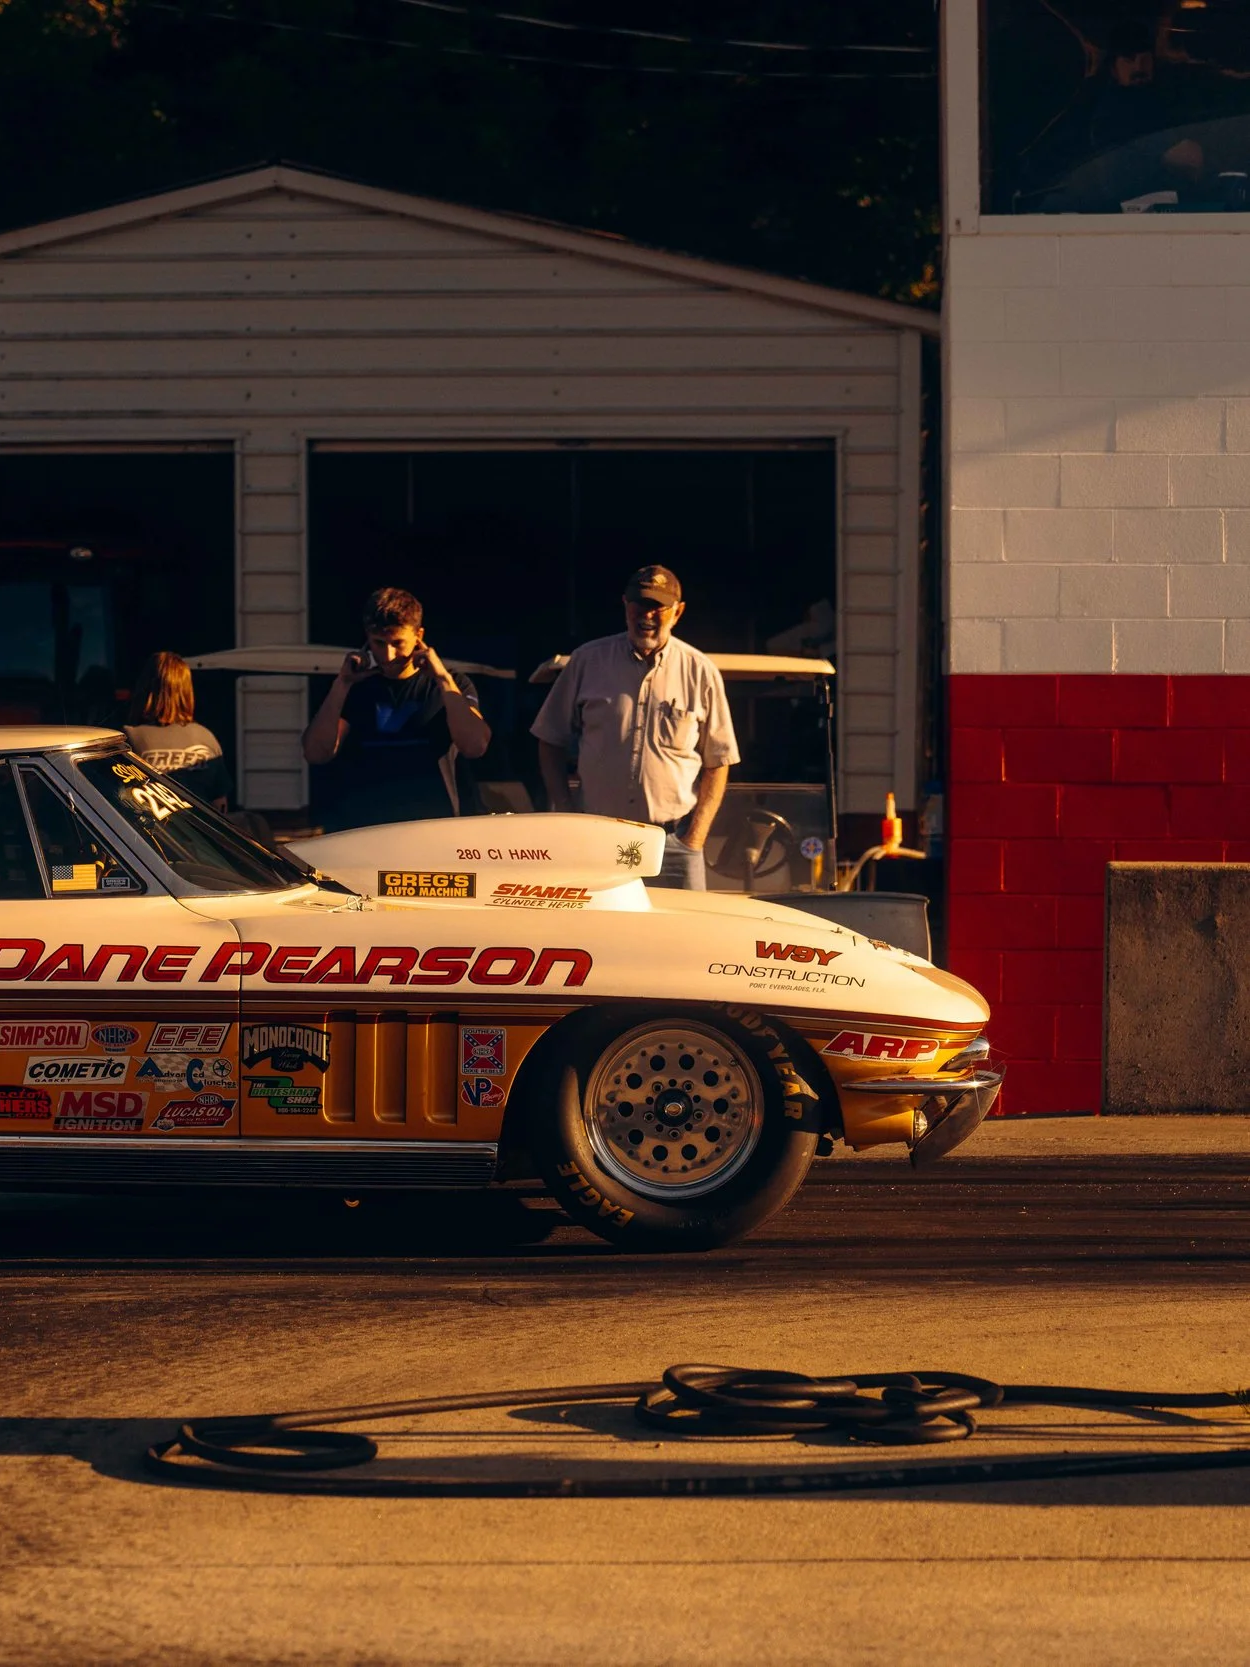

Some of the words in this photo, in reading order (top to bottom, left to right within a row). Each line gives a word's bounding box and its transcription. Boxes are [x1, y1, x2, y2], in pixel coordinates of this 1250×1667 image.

[132, 782, 193, 820] 2142
[456, 849, 481, 860] 280
[487, 849, 503, 860] CI
[508, 849, 552, 861] HAWK
[384, 873, 470, 888] GREG'S
[386, 886, 416, 896] AUTO
[418, 887, 468, 897] MACHINE
[492, 882, 593, 901] SHAMEL
[492, 897, 545, 908] CYLINDER
[547, 901, 585, 909] HEADS
[198, 942, 594, 987] PEARSON
[707, 963, 866, 988] CONSTRUCTION
[98, 1026, 133, 1043] NHRA
[152, 1025, 226, 1046] CFE
[243, 1026, 330, 1062] MONOCOQUE
[825, 1031, 939, 1059] ARP
[28, 1060, 126, 1079] COMETIC
[198, 1095, 219, 1105] NHRA
[250, 1087, 316, 1097] DRIVESHAFT
[286, 1096, 317, 1104] SHOP
[462, 1078, 492, 1107] VP
[60, 1091, 143, 1118] MSD
[164, 1106, 205, 1118] LUCAS
[206, 1106, 226, 1117] OIL
[58, 1118, 137, 1131] IGNITION
[556, 1160, 636, 1228] EAGLE
